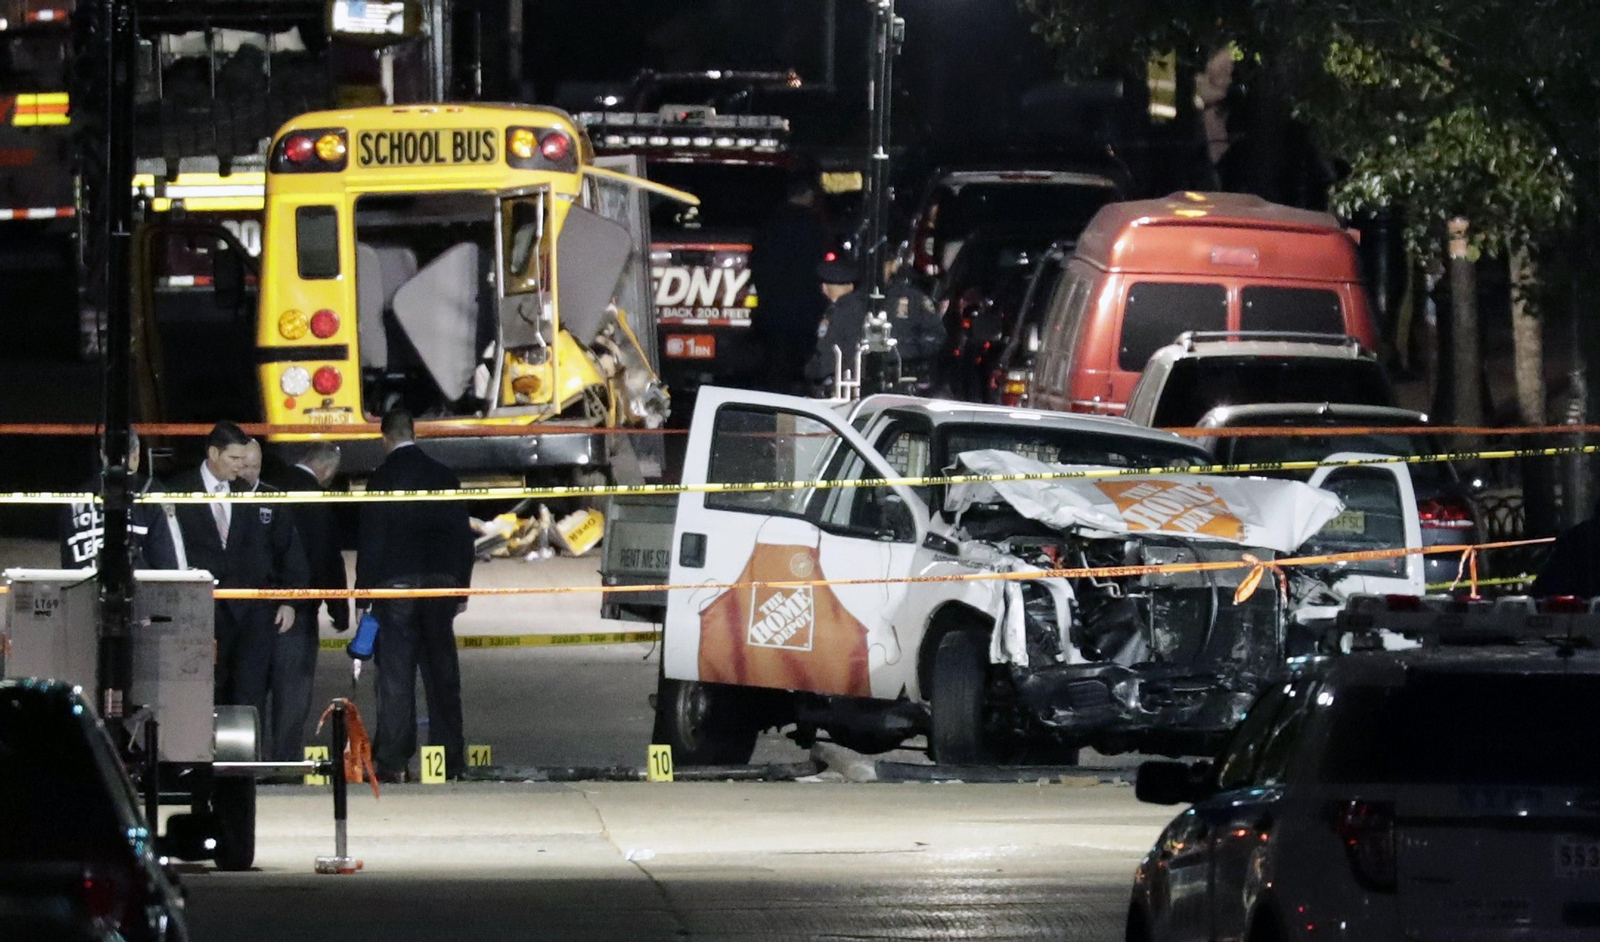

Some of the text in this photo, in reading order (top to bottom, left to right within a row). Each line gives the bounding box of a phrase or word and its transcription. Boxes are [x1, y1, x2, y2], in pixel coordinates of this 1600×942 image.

[360, 130, 495, 165] SCHOOL BUS
[663, 307, 693, 318] BACK
[697, 308, 720, 318] 200
[724, 308, 751, 318] FEET
[1119, 483, 1162, 500] THE
[758, 591, 787, 615] THE
[750, 587, 812, 645] HOME
[772, 610, 812, 646] DEPOT
[425, 752, 443, 777] 12
[653, 751, 670, 775] 10
